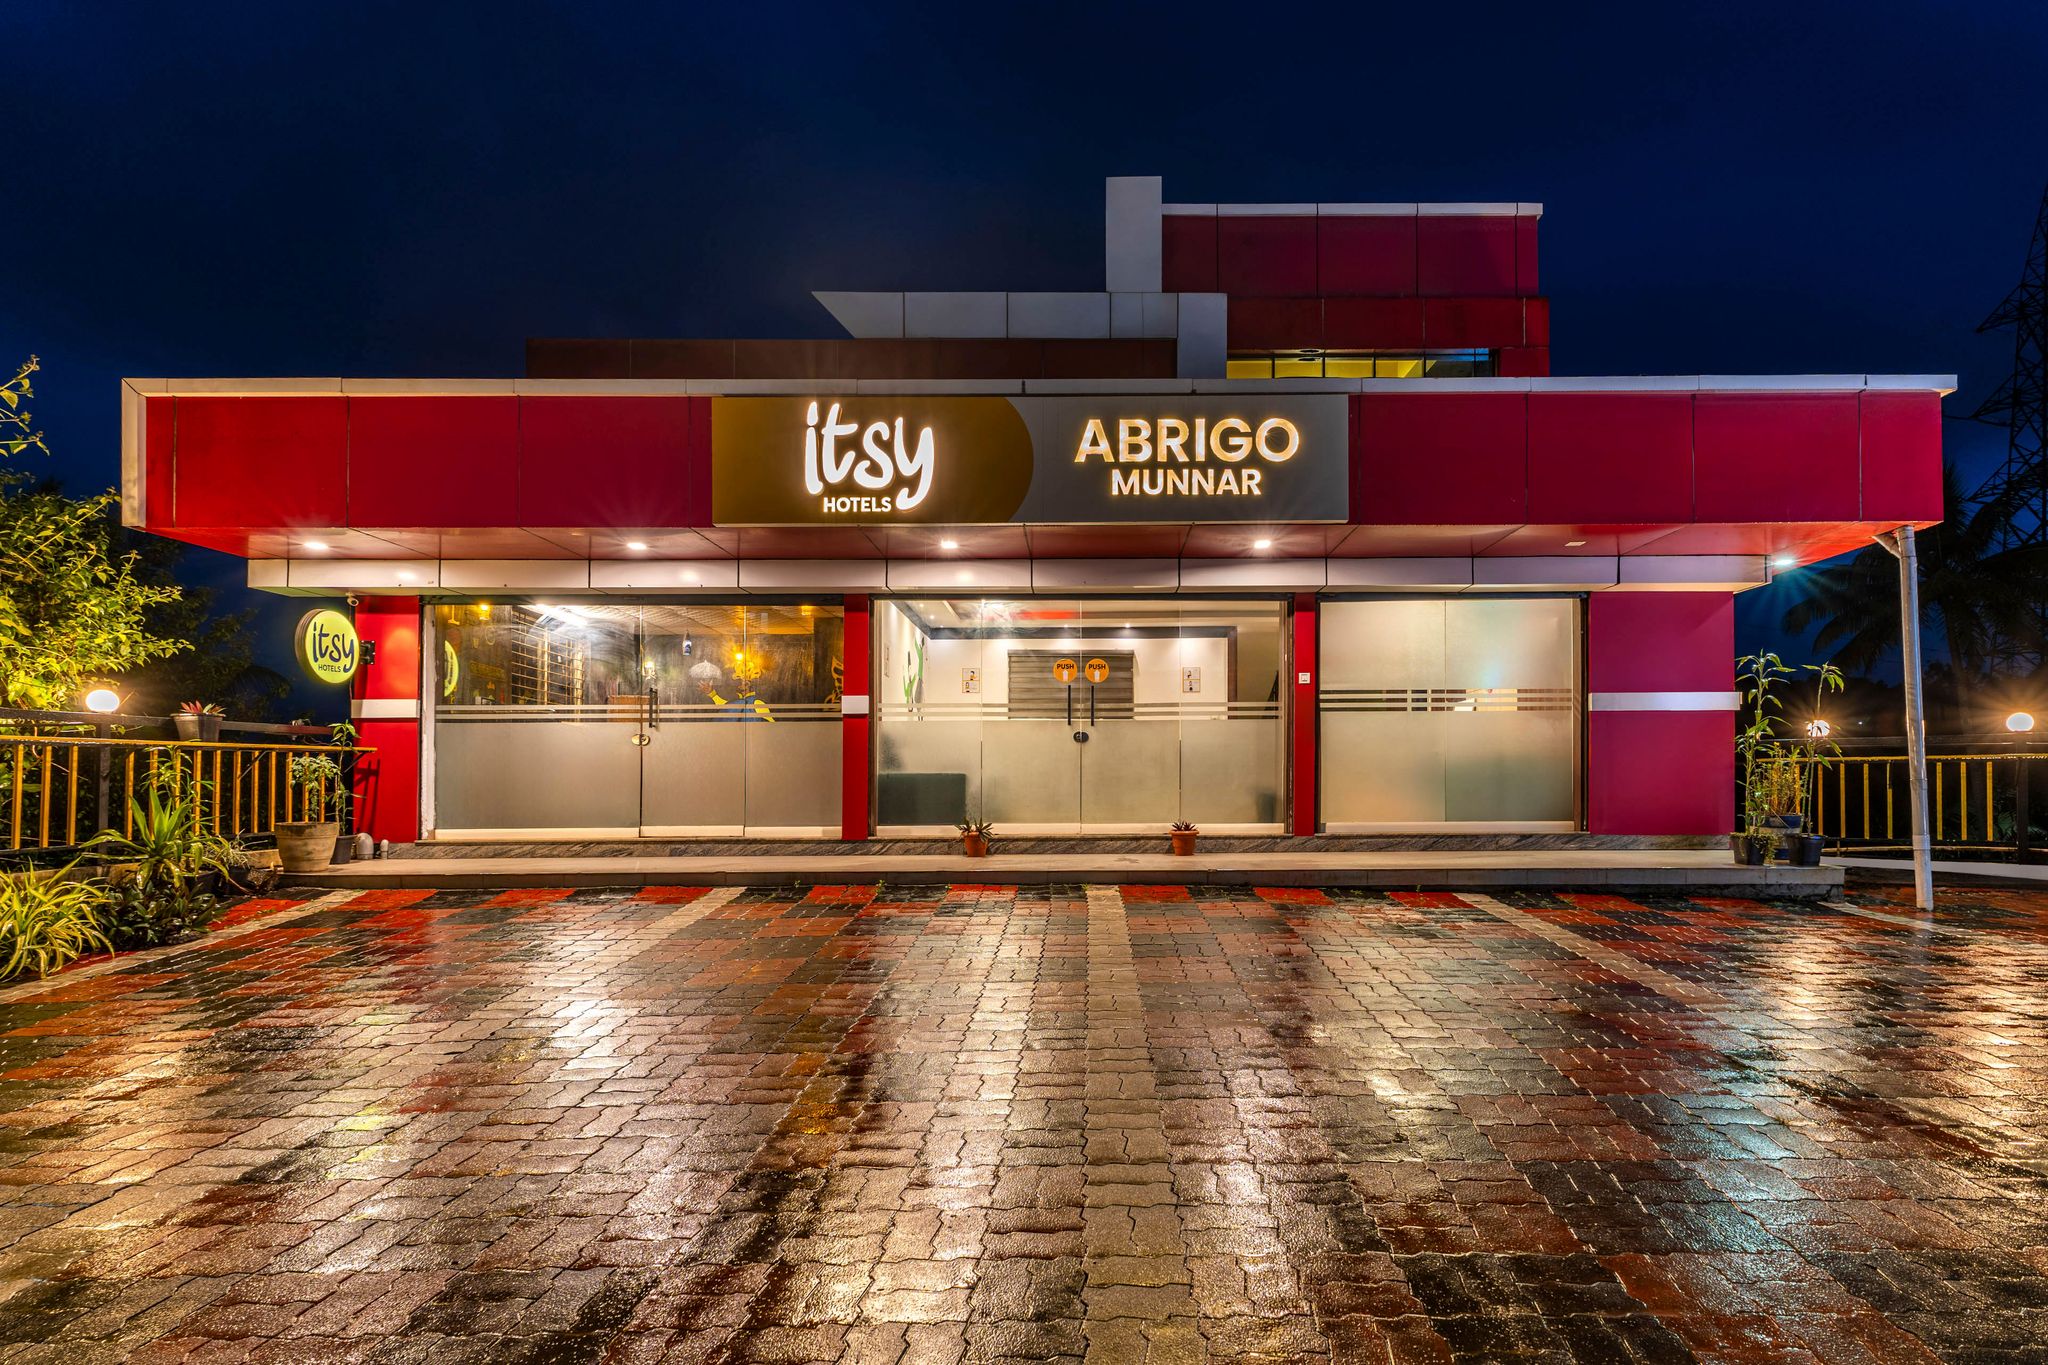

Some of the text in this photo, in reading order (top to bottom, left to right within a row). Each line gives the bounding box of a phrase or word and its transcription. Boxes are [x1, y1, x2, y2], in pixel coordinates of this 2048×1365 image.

[805, 401, 935, 510] itsy
[1074, 418, 1299, 462] ABRIGO
[1111, 468, 1262, 495] MUNNAR
[823, 497, 892, 512] HOTELS
[313, 621, 354, 673] itsy
[318, 664, 342, 672] HOTELS
